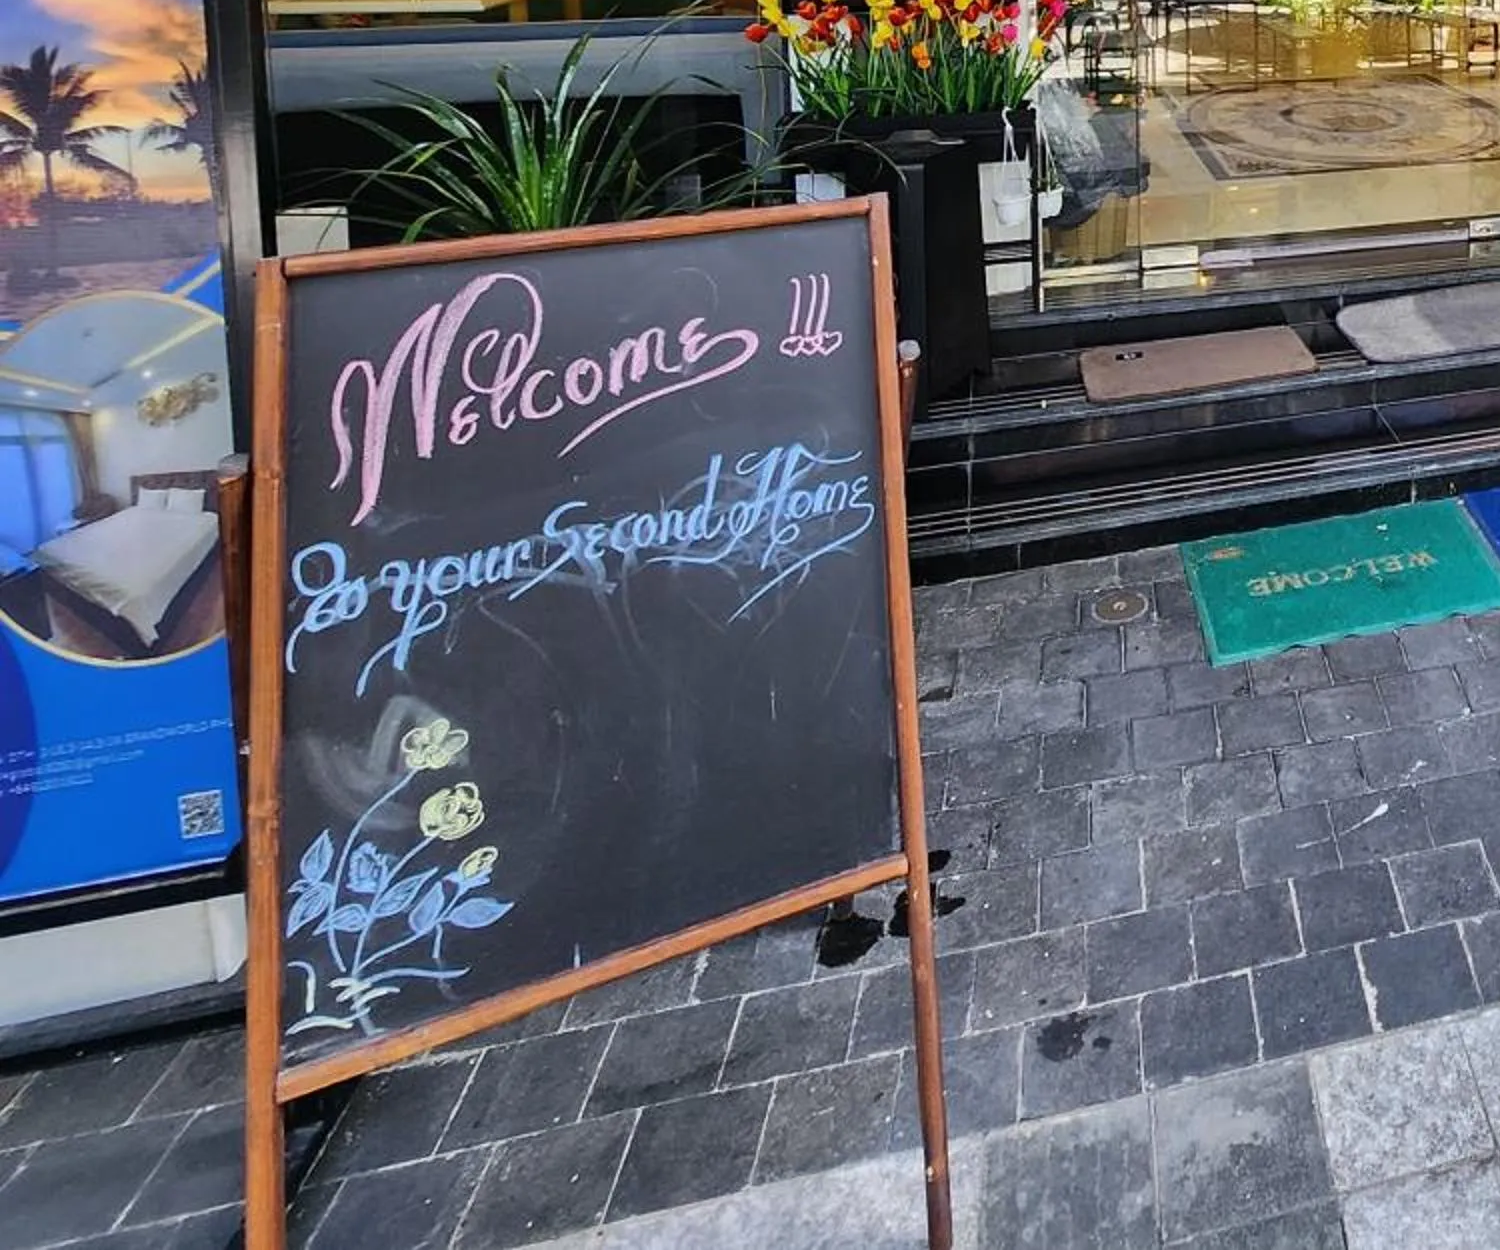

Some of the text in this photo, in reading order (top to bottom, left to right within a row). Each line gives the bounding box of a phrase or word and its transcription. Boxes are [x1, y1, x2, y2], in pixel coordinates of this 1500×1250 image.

[329, 273, 759, 527] Welcome
[508, 454, 726, 600] Second
[647, 443, 875, 624] Home
[1246, 549, 1439, 597] WELCOME
